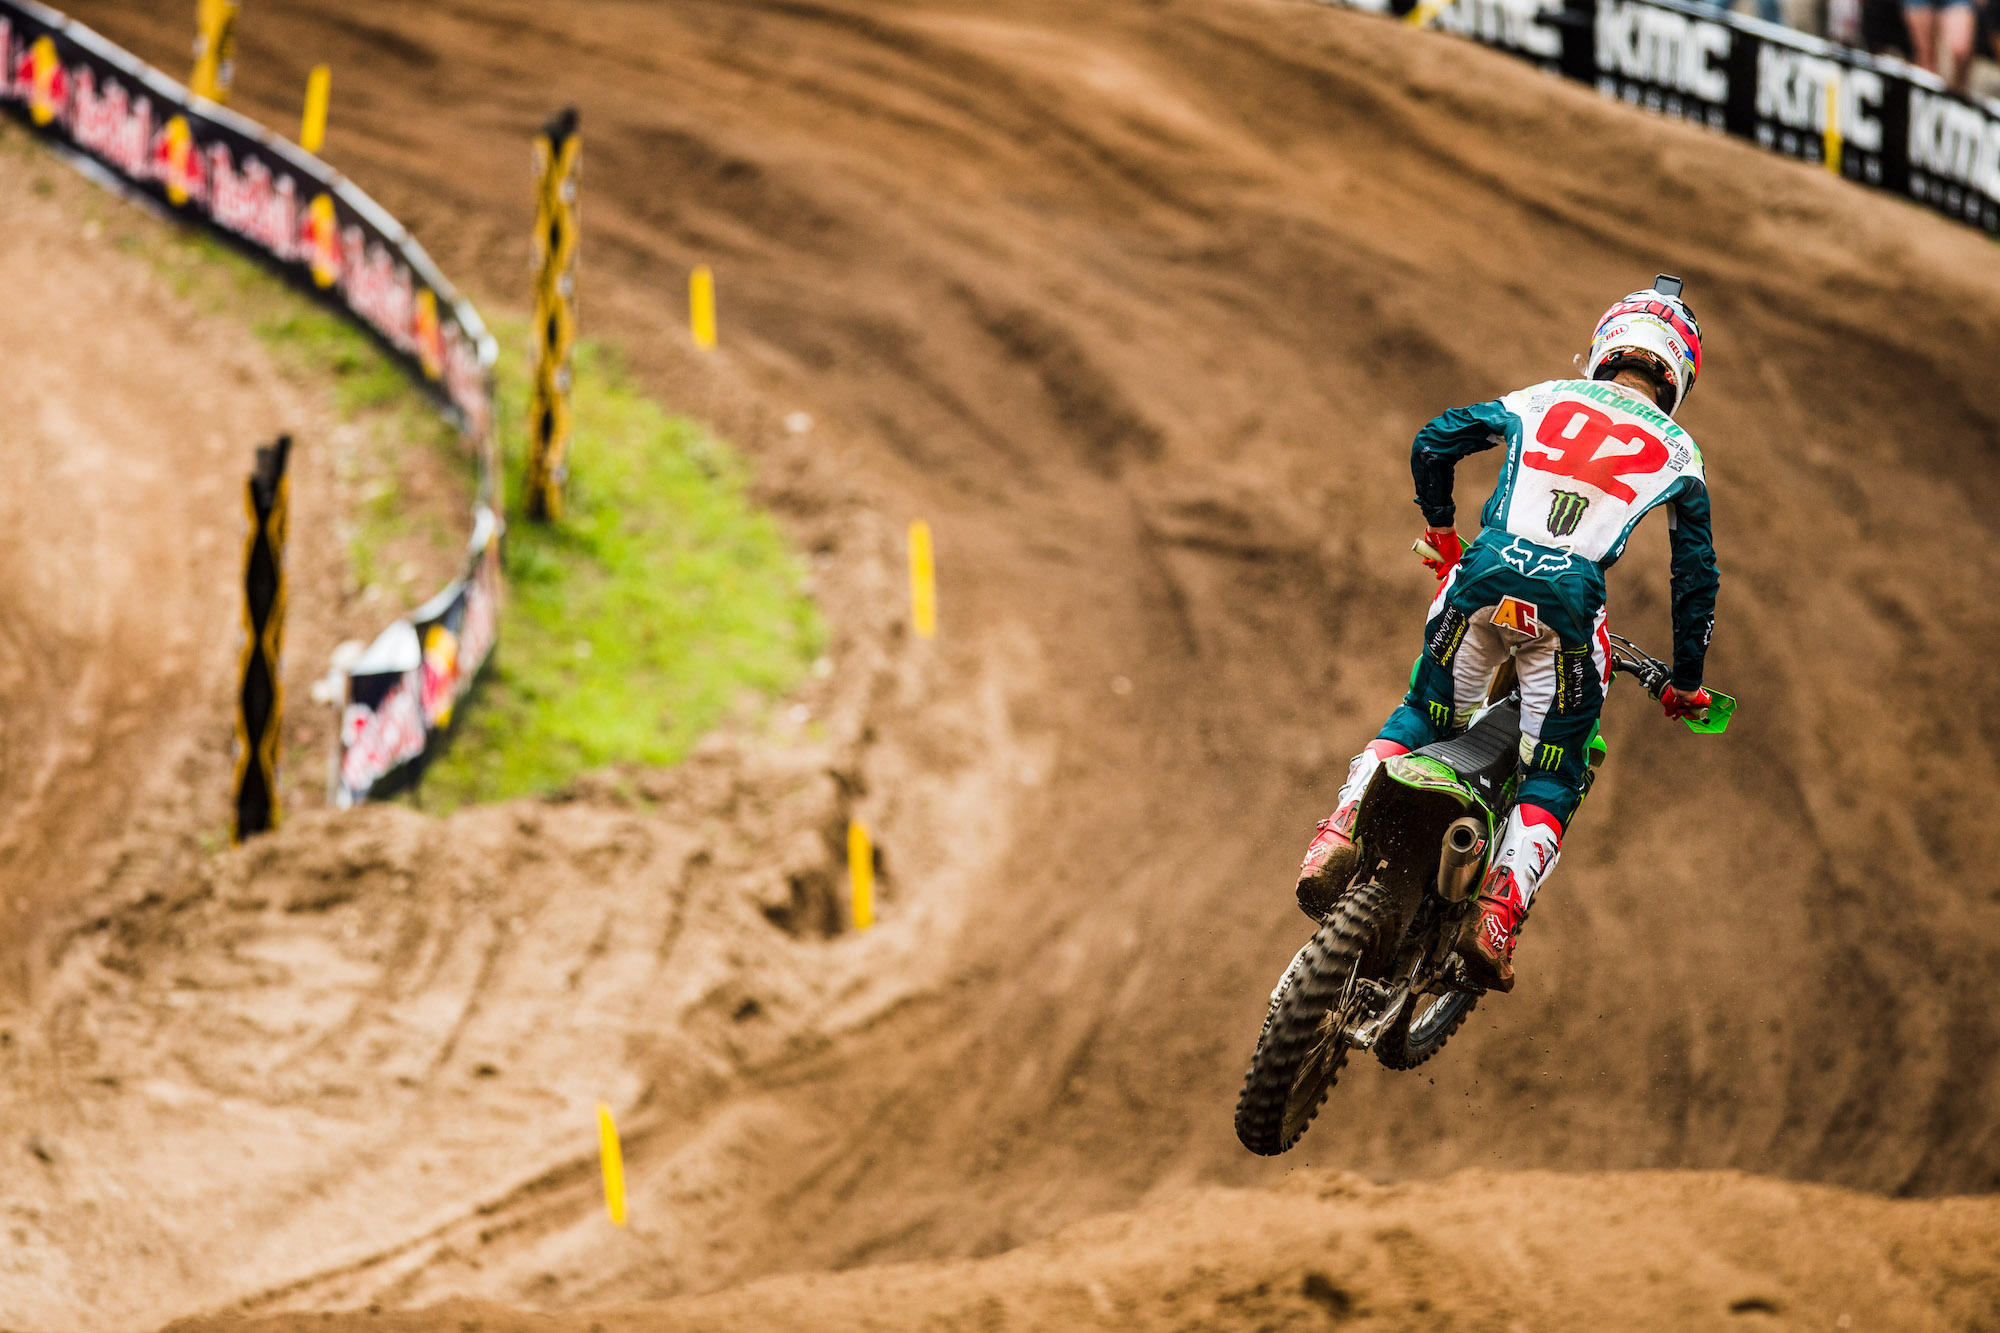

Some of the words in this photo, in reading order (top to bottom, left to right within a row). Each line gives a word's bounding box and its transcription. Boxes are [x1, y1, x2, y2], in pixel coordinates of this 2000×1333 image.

[1595, 0, 1732, 103] KMC
[1756, 41, 1885, 152] KMC
[1605, 327, 1625, 341] BELL
[1668, 340, 1683, 362] BELL
[1522, 400, 1669, 506] 92
[1429, 606, 1457, 651] MONSTER
